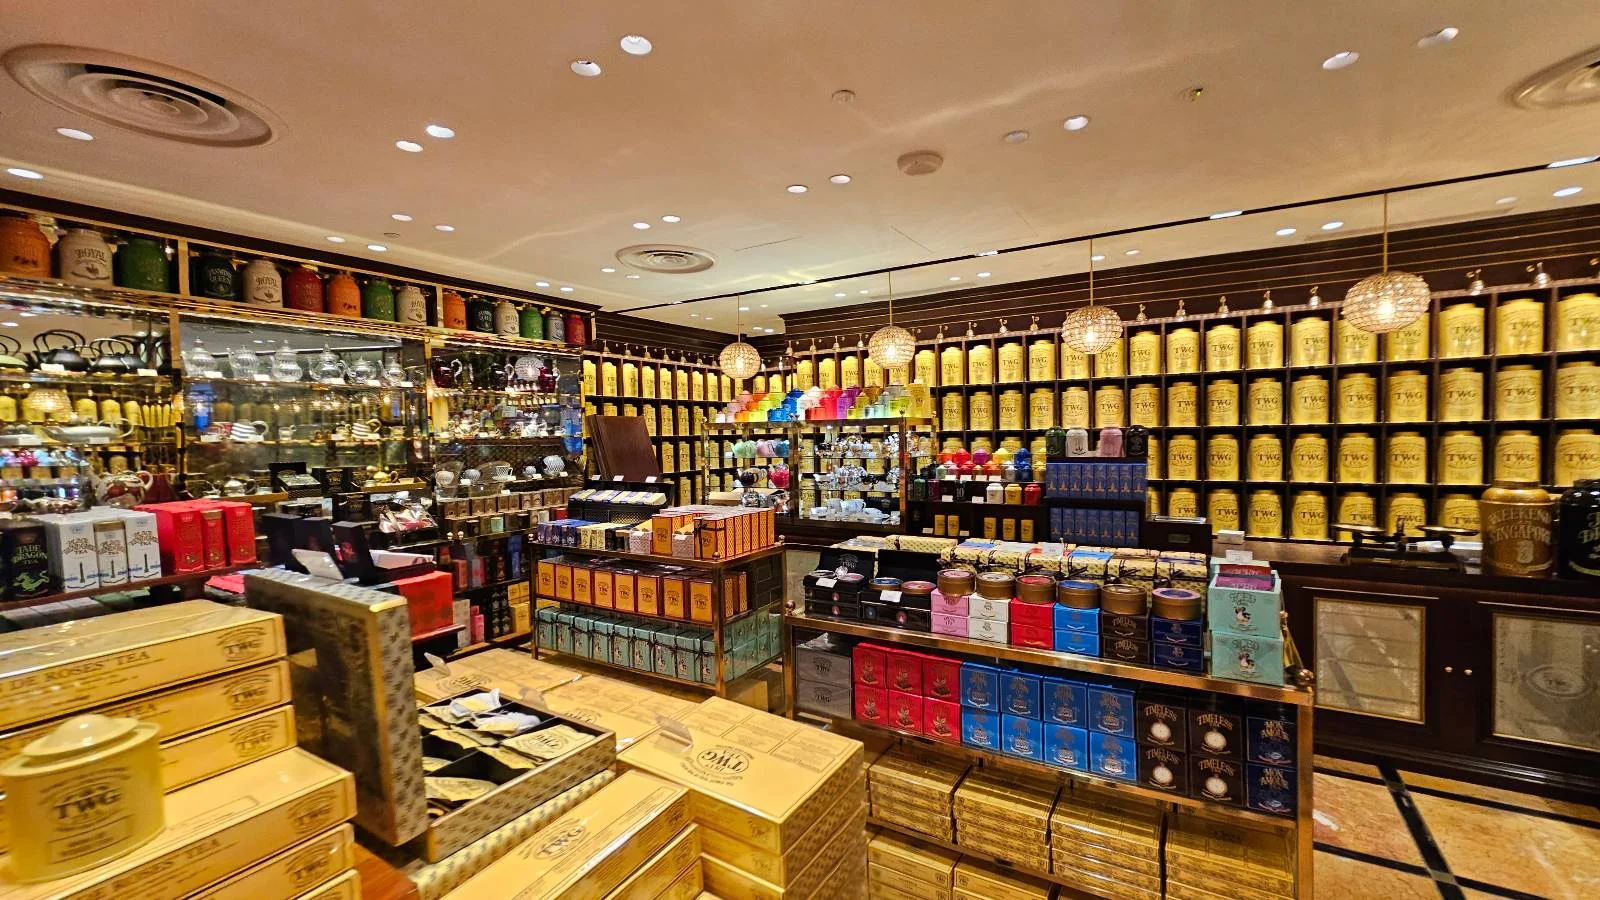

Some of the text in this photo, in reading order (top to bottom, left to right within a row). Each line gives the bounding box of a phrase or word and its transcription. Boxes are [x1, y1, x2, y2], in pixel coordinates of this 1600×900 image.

[1510, 321, 1539, 330] TWG
[1569, 317, 1600, 327] TWG
[1395, 329, 1420, 338] TWG
[1454, 326, 1480, 335] TWG
[1304, 336, 1326, 344] TWG
[1343, 334, 1368, 342] TWG
[1252, 341, 1274, 349] TWG
[1447, 389, 1478, 398] TWG
[1505, 387, 1537, 396] TWG
[1566, 385, 1600, 395] TWG
[1348, 394, 1374, 402] TWG
[1395, 391, 1423, 399] TWG
[1135, 402, 1156, 410] TWG
[1172, 453, 1193, 461] TWG
[1210, 453, 1231, 461] TWG
[1257, 453, 1281, 461] TWG
[1300, 453, 1324, 461] TWG
[1342, 453, 1369, 461] TWG
[1393, 453, 1420, 461] TWG
[1448, 453, 1477, 462] TWG
[1504, 453, 1535, 462] TWG
[1565, 453, 1600, 462] TWG
[1217, 508, 1237, 516] TWG
[1254, 509, 1276, 517] TWG
[1301, 511, 1325, 519] TWG
[1351, 513, 1375, 521] TWG
[225, 639, 262, 655] TWG
[44, 661, 105, 681] ROSES
[116, 651, 150, 666] TEA
[231, 687, 267, 703] TWG
[1144, 704, 1178, 722] TIMELESS
[1196, 713, 1233, 730] TIMELESS
[701, 750, 744, 772] TWG
[1199, 759, 1234, 777] TIMELESS
[53, 787, 122, 820] TWG
